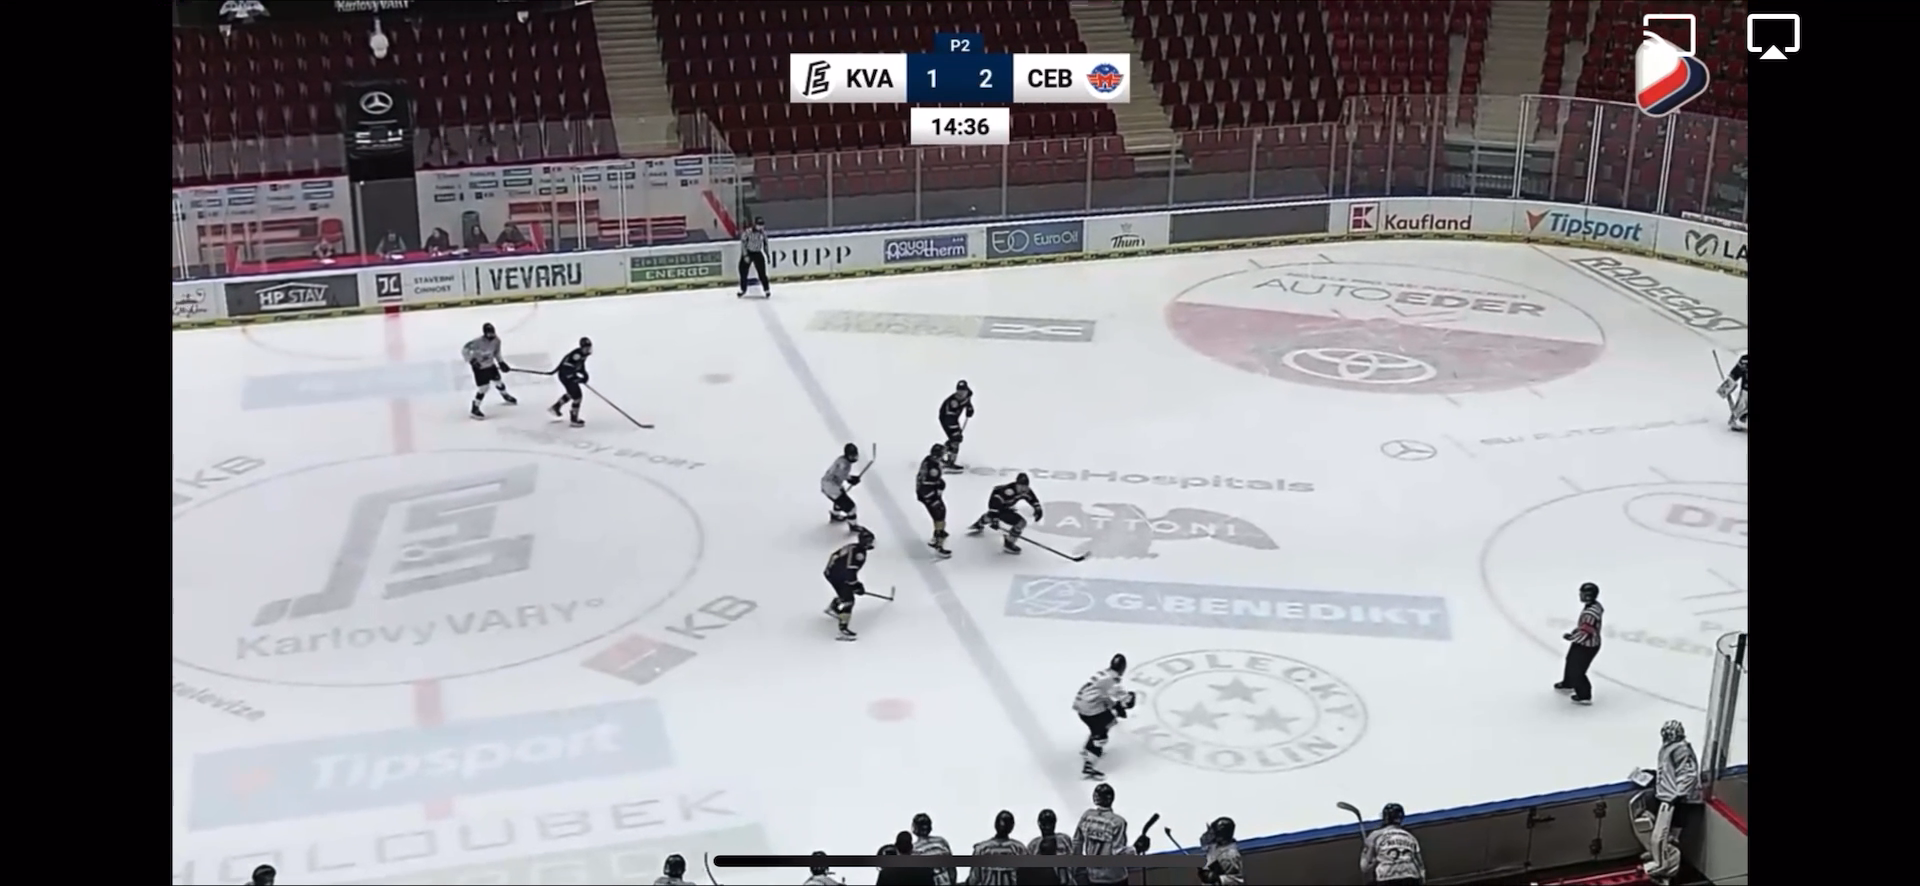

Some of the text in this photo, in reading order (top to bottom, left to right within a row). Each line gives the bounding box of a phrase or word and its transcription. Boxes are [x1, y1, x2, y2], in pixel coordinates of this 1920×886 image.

[1384, 214, 1472, 231] Kaufland
[1549, 212, 1644, 242] Tipsport
[772, 246, 852, 268] PUPP
[645, 267, 710, 281] ENERGO
[259, 287, 327, 306] HP STAV
[1570, 256, 1748, 332] RADEGAS
[962, 465, 1315, 493] entaHospitals
[1037, 515, 1237, 537] ATTONI
[664, 595, 758, 640] KB
[236, 618, 436, 661] Karlovy
[310, 722, 622, 791] Tipsport
[1131, 722, 1339, 769] KAOLIN
